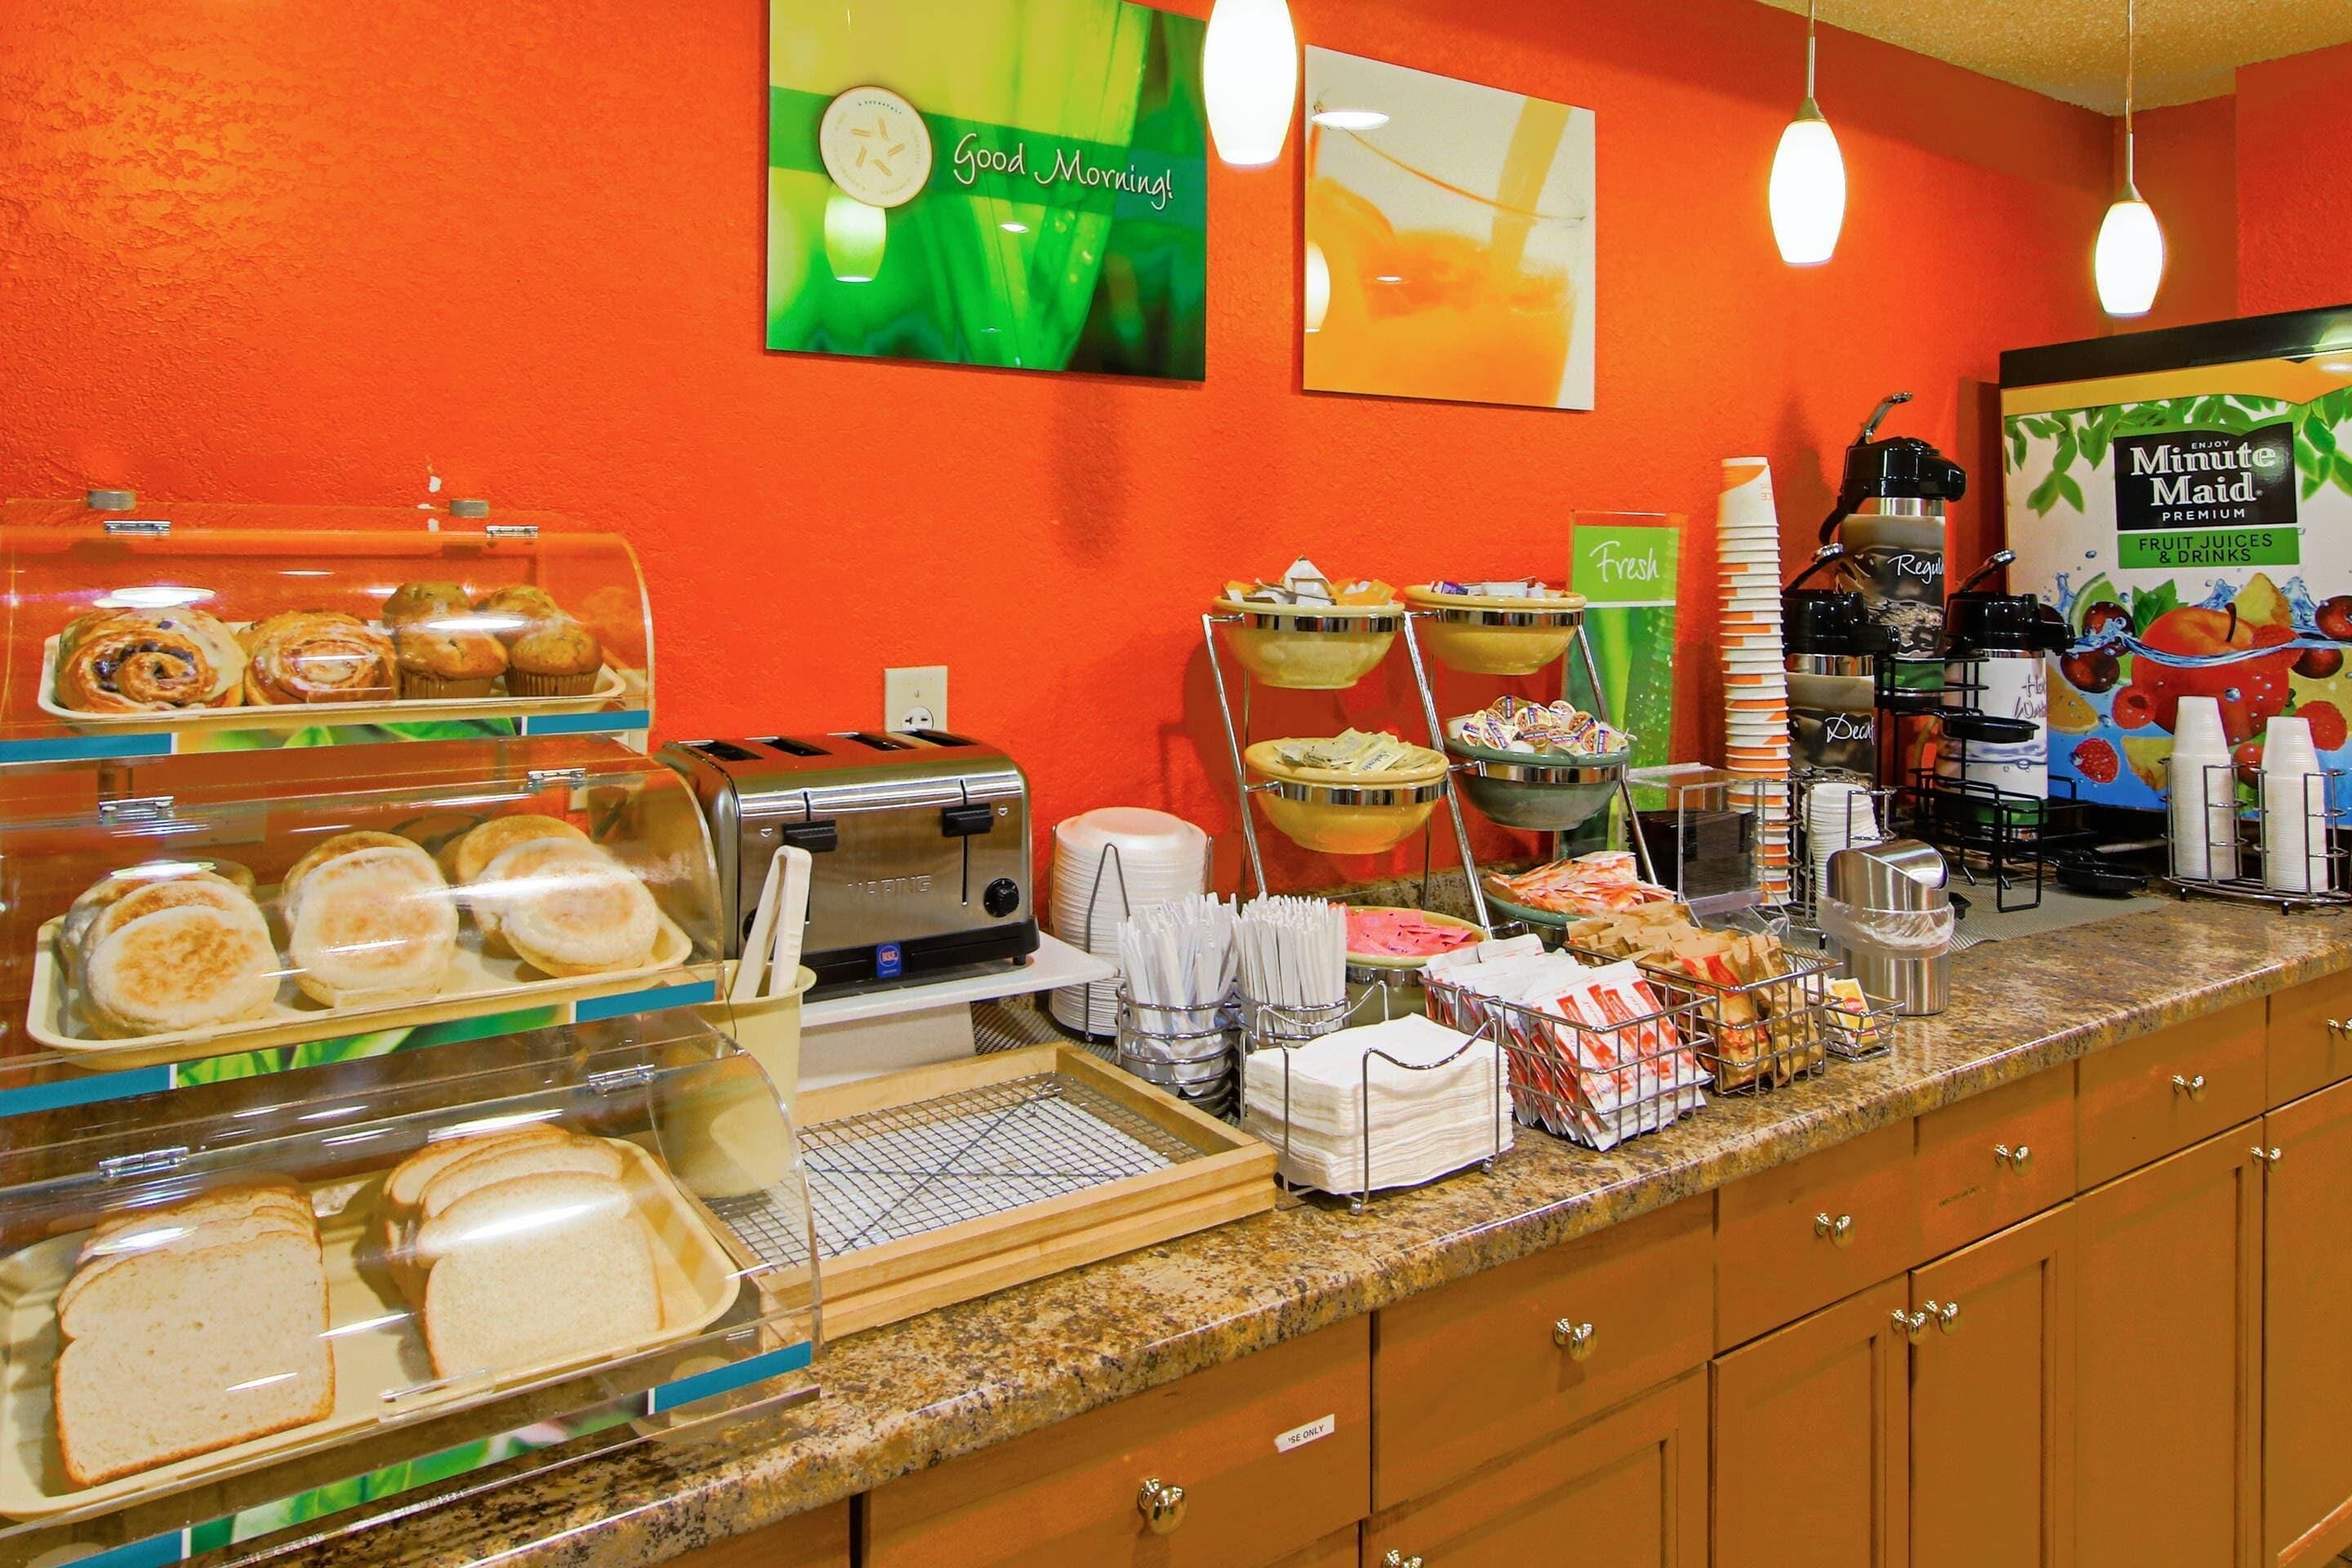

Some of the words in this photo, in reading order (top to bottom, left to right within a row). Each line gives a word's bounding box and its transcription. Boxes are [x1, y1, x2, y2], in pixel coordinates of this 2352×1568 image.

[953, 132, 1026, 185] Good
[1033, 148, 1174, 211] Morning!
[2191, 439, 2230, 450] ENJOY
[2129, 441, 2277, 476] Minute
[2149, 471, 2258, 507] Maid
[2162, 508, 2246, 522] PREMIUM
[2139, 536, 2194, 551] FRUIT
[2199, 533, 2273, 550] JUICES
[1588, 540, 1660, 583] Fresh
[2158, 550, 2172, 564] &
[2178, 548, 2252, 564] DRINKS
[1303, 1423, 1325, 1439] ONLY
